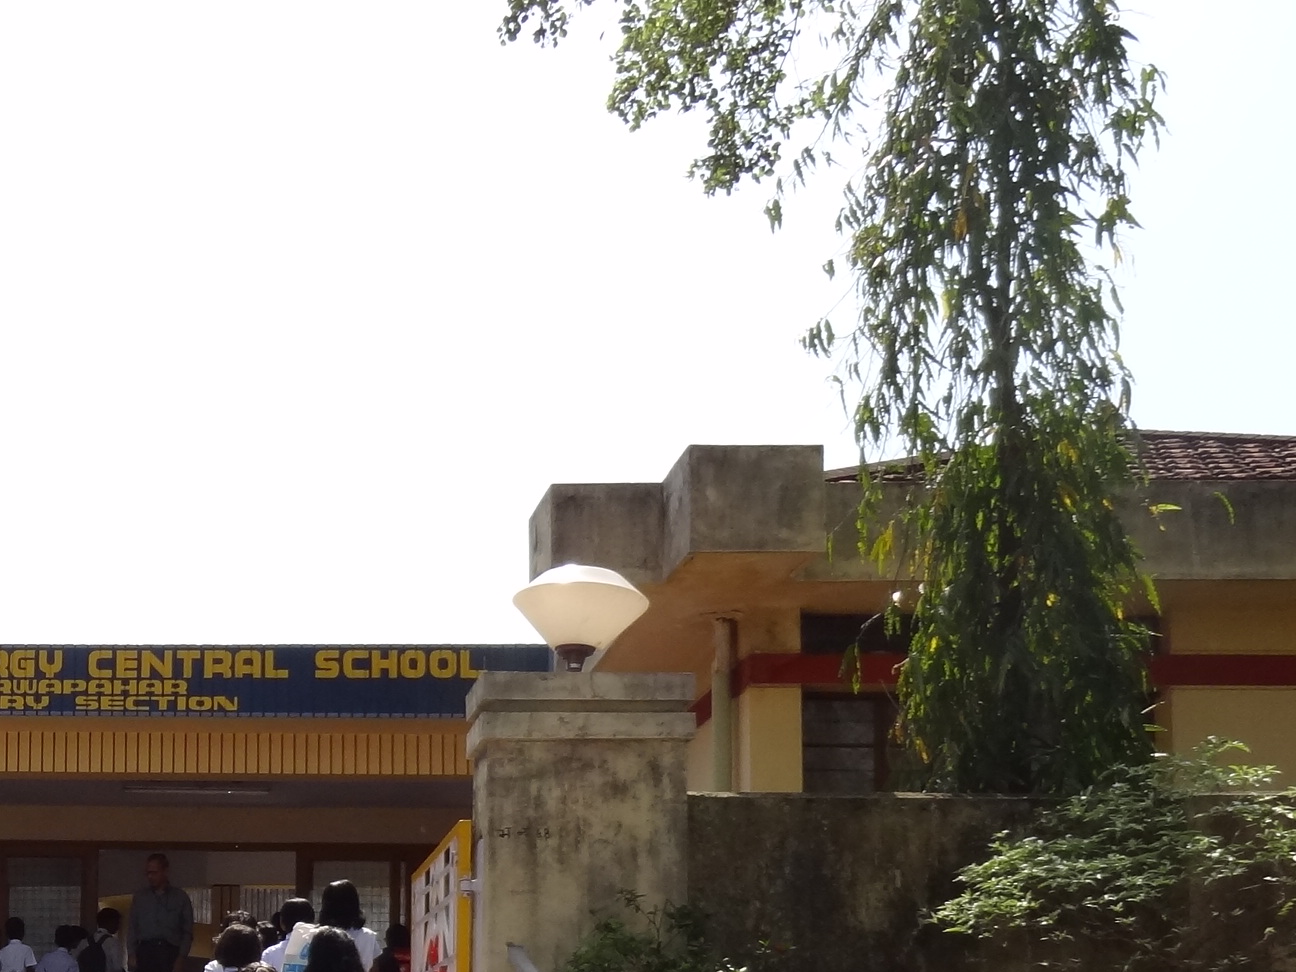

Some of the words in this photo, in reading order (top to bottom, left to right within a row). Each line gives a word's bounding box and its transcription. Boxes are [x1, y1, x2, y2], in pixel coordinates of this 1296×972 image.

[88, 650, 289, 679] CENTRAL
[314, 649, 486, 679] SCHOOL
[75, 695, 238, 711] SECTION
